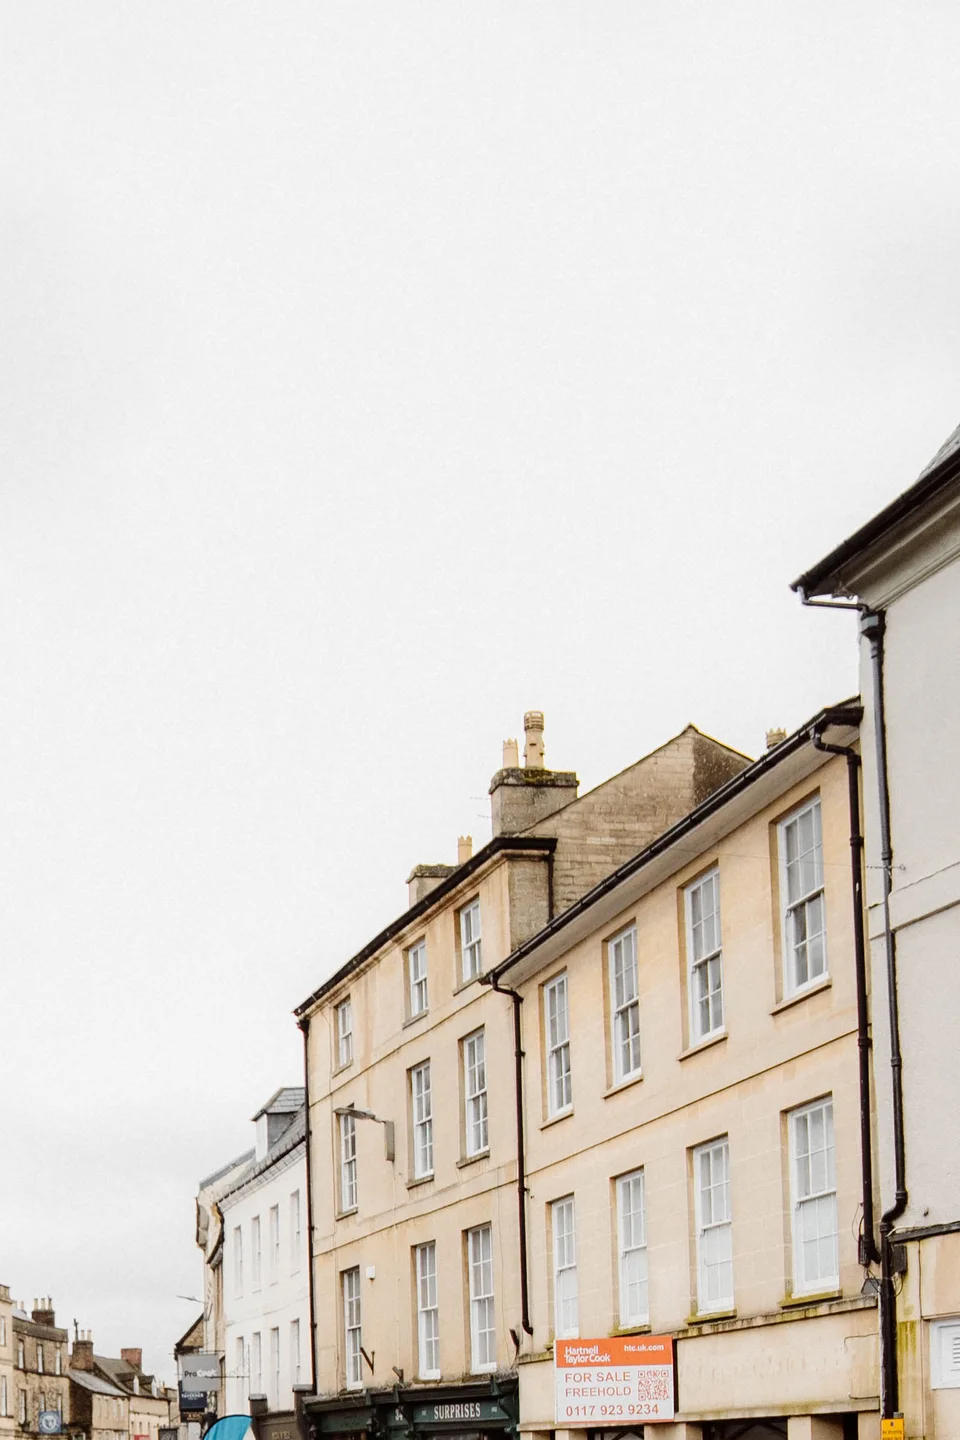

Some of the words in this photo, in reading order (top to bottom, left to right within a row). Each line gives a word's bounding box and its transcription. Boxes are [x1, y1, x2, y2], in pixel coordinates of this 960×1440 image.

[565, 1345, 599, 1356] Hartnell
[624, 1344, 664, 1352] htc.uk.com
[564, 1354, 589, 1365] Taylor
[589, 1354, 611, 1363] Cook
[565, 1372, 592, 1383] FOR
[596, 1371, 631, 1382] SALE
[565, 1386, 632, 1397] FREEHOLD
[434, 1402, 481, 1420] SURPRISES
[566, 1405, 596, 1417] 0117
[600, 1404, 624, 1415] 923
[628, 1403, 659, 1415] 9234
